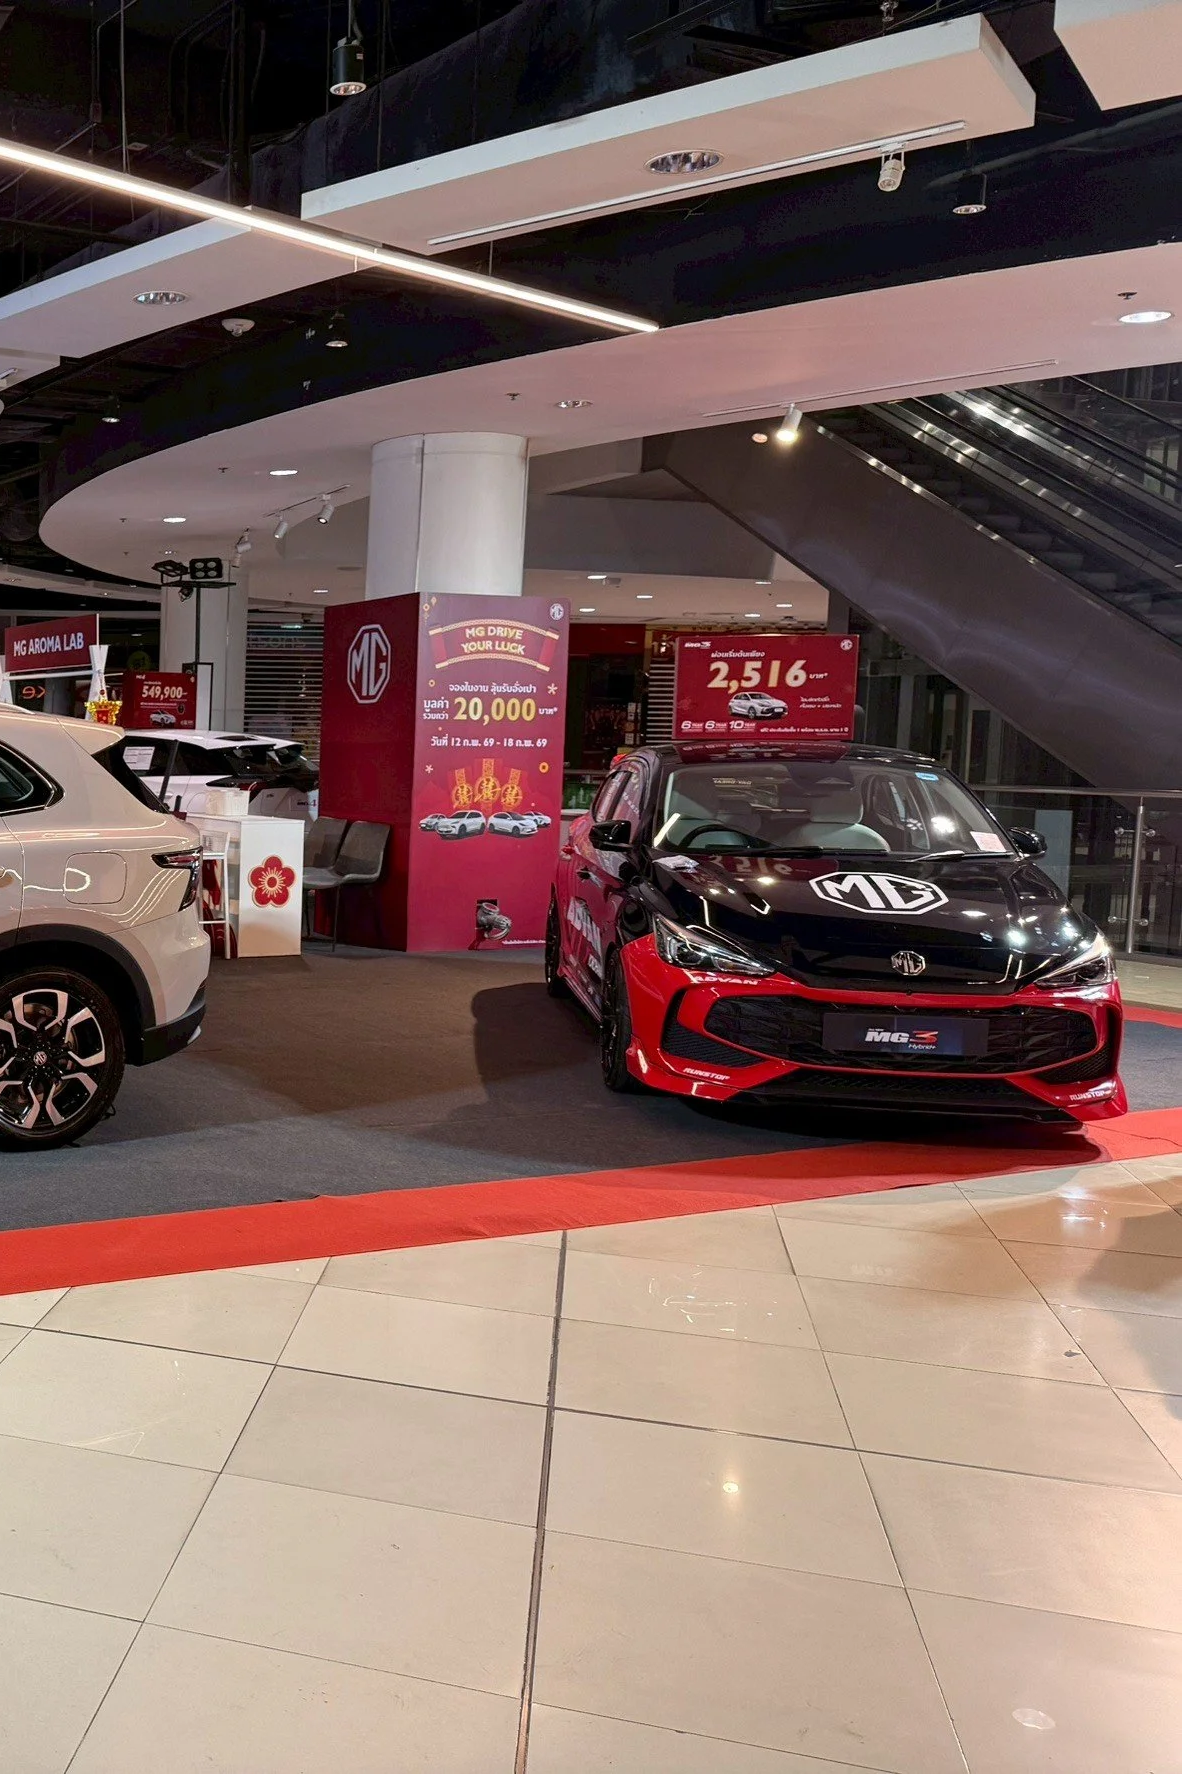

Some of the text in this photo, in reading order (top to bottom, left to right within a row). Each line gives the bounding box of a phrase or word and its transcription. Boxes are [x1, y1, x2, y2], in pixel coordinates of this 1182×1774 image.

[465, 626, 523, 640] MG DRIVE
[13, 632, 84, 657] MG AROMA LAB
[461, 641, 525, 655] YOUR LUCK
[349, 628, 389, 699] MG
[707, 660, 807, 694] 2,516
[141, 685, 183, 701] 549,900
[448, 681, 537, 695] จองในงาน ลุ้นรับอั่งเปา
[423, 697, 450, 712] มูลค่า
[453, 697, 536, 726] 20,000
[422, 711, 449, 720] รวมกว่า
[681, 721, 692, 729] 6
[705, 720, 716, 729] 6
[729, 720, 744, 729] 10
[430, 734, 449, 747] วันที่
[450, 737, 461, 746] 12
[463, 738, 481, 747] ก.พ.
[483, 738, 495, 747] 69
[503, 738, 514, 747] 18
[516, 739, 534, 748] ก.พ.
[536, 739, 548, 747] 69
[814, 873, 944, 913] MG
[892, 952, 925, 975] MG
[694, 976, 758, 985] ADVAN
[865, 1030, 938, 1044] MG3
[683, 1067, 730, 1081] RUNSTOP
[1069, 1089, 1106, 1101] RUNSTOP
